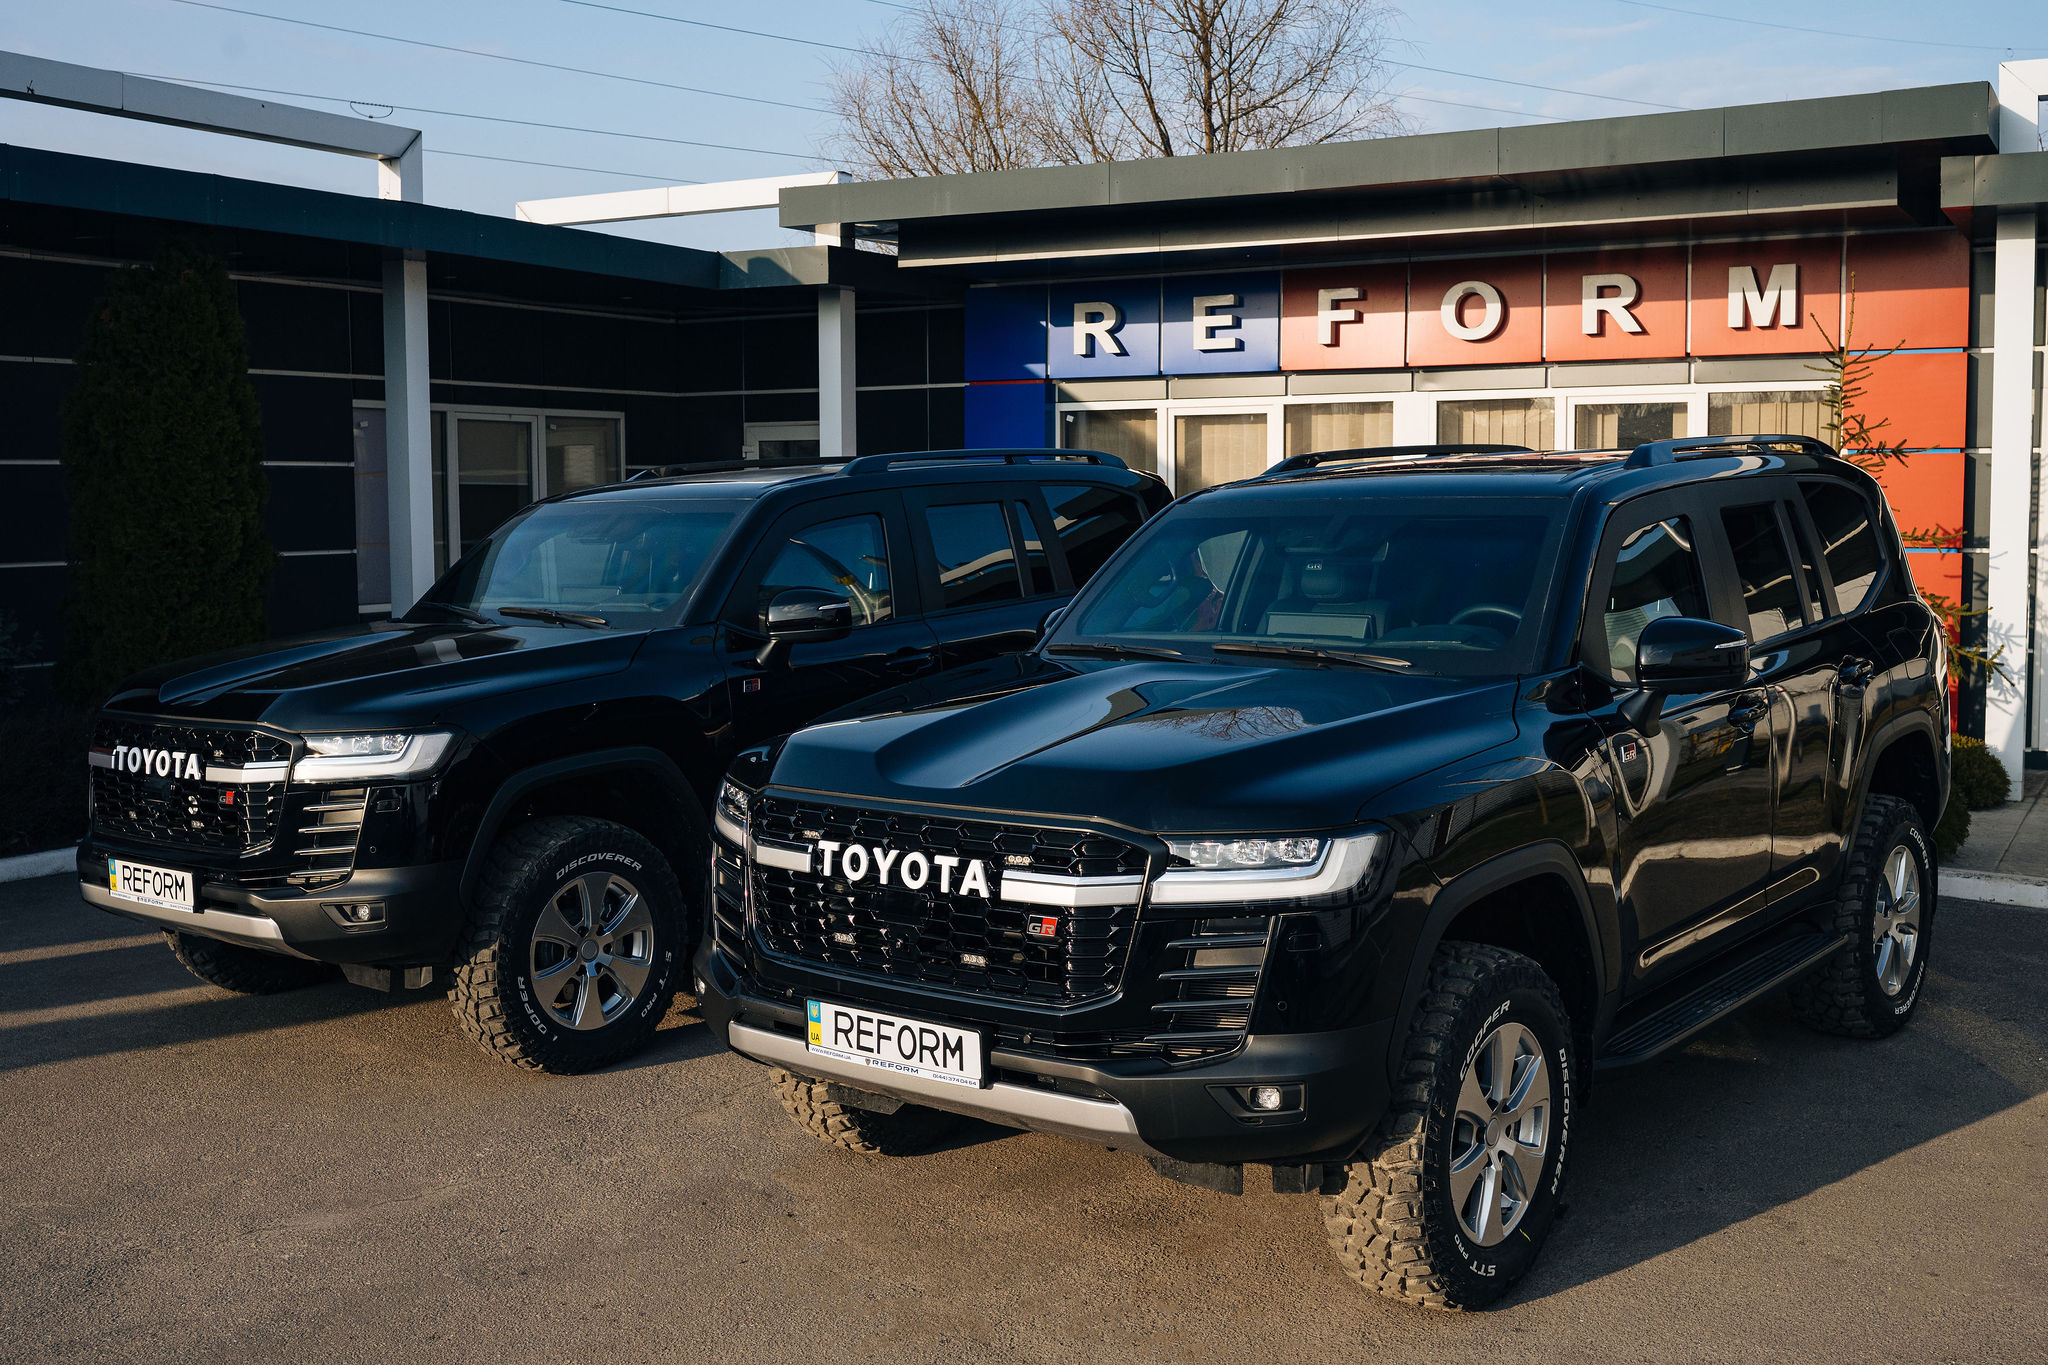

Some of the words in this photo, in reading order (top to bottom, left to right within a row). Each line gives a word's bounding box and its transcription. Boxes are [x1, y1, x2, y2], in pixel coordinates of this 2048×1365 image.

[1073, 263, 1800, 355] REFORM
[116, 745, 200, 780] TOYOTA
[556, 852, 643, 880] DISCOVERER
[1909, 827, 1930, 870] COOPER
[122, 865, 186, 901] REFORM
[817, 840, 990, 898] TOYOTA
[1028, 922, 1055, 935] GR
[517, 976, 569, 1042] OOPER
[811, 1032, 820, 1042] UA
[834, 1010, 964, 1072] REFORM
[1459, 1000, 1511, 1081] COOPER
[872, 1059, 919, 1075] REFORM
[1550, 1047, 1570, 1196] DISCOVERER
[1454, 1234, 1469, 1260] PRO
[1470, 1261, 1496, 1277] STT
